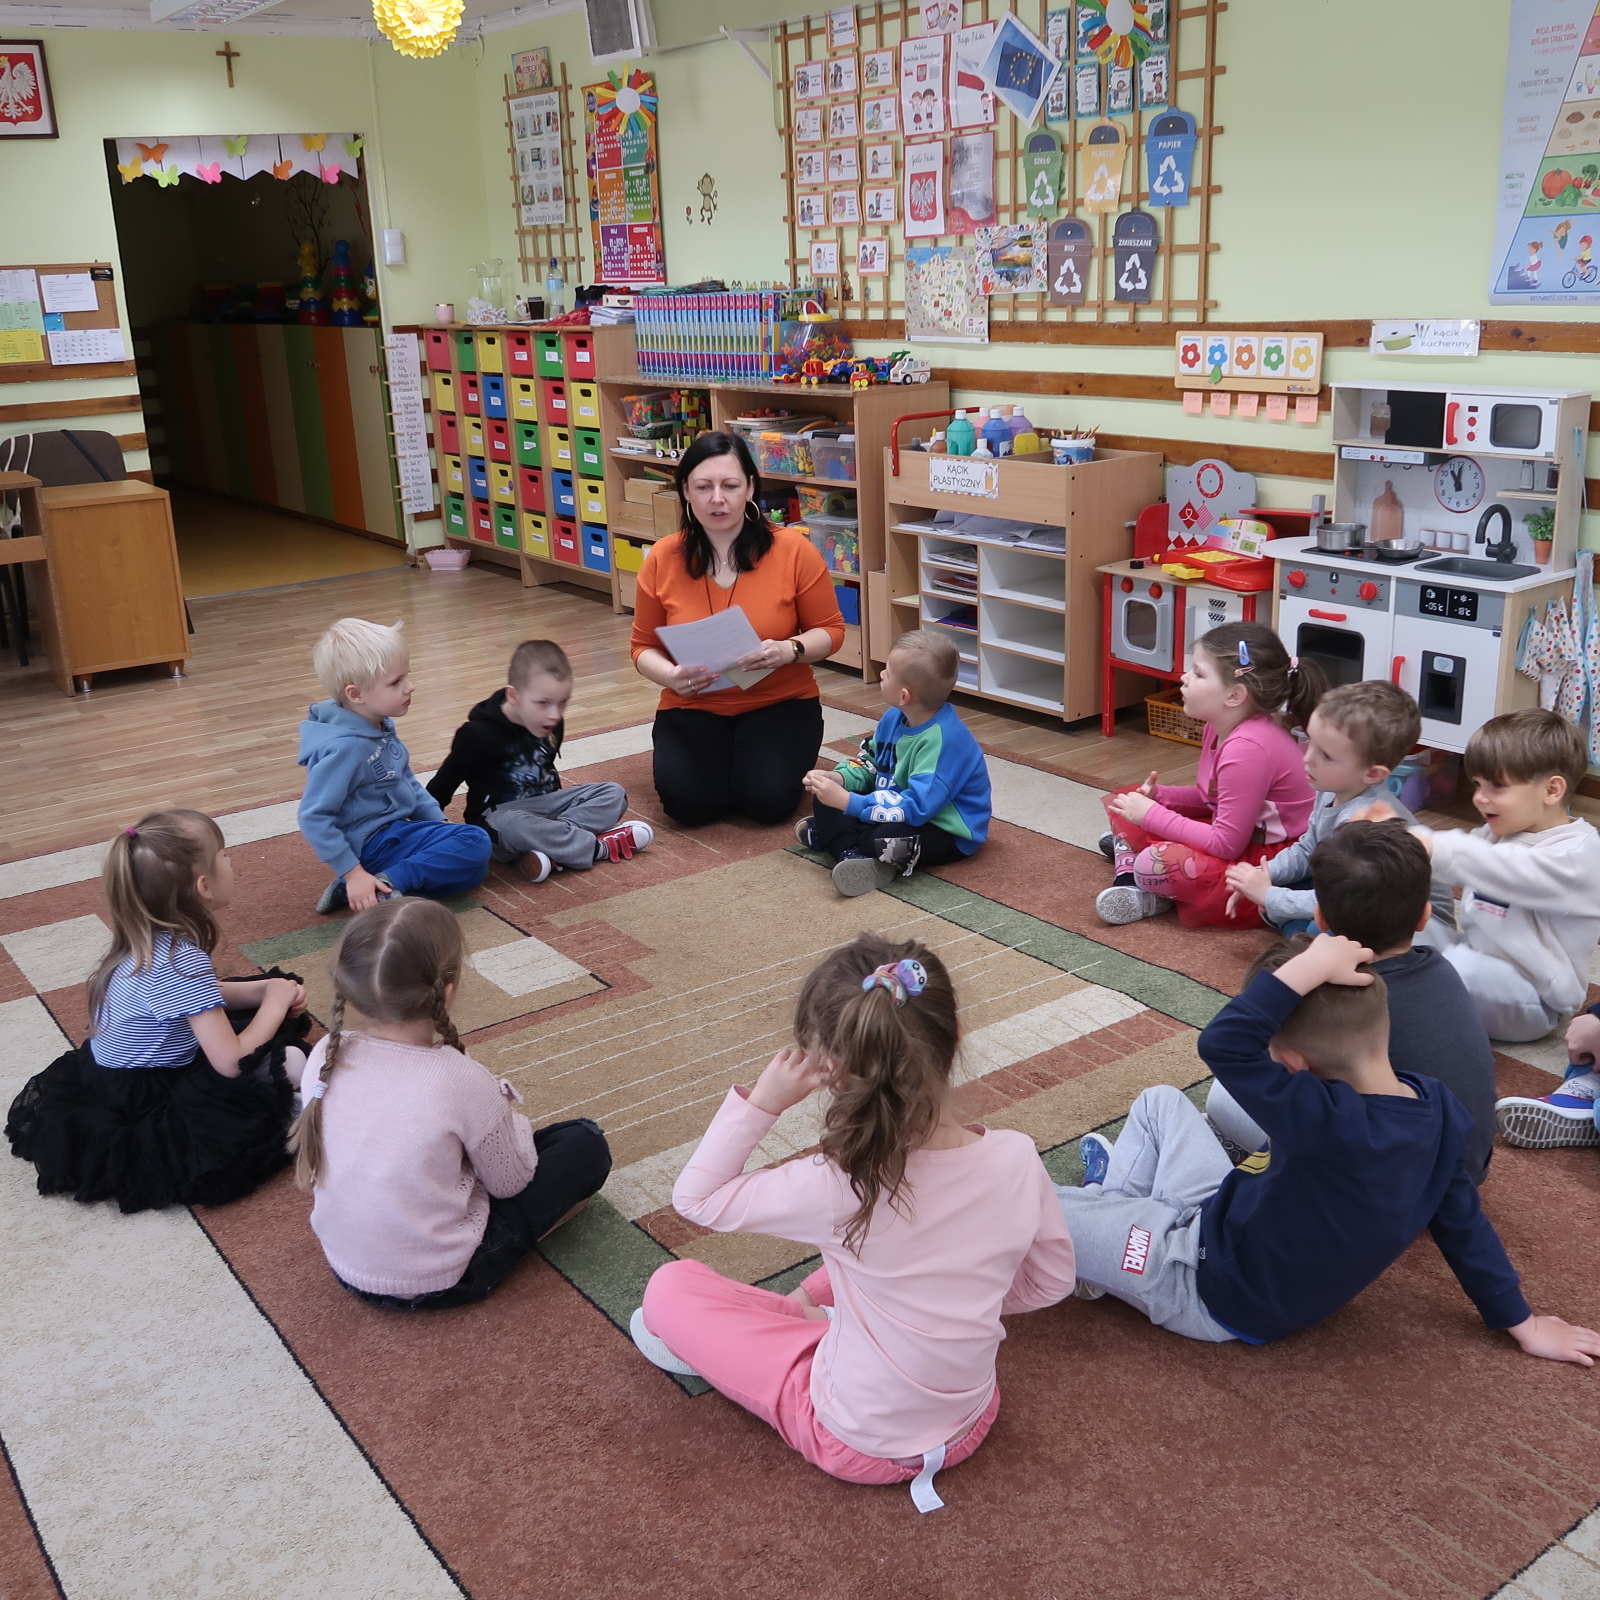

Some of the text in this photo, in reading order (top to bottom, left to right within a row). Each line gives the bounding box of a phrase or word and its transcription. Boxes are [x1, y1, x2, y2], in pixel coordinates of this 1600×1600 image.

[1158, 141, 1181, 149] PAPIER
[1091, 150, 1115, 158] PLASTIK
[1034, 157, 1050, 165] SZKŁO
[1118, 239, 1152, 248] ZMIESZANE
[1434, 329, 1460, 338] kącik
[1420, 339, 1472, 348] kuchenny
[947, 464, 969, 476] KĄCIK
[933, 475, 981, 489] PLASTYCZNY
[1122, 1225, 1151, 1272] MARVEL
